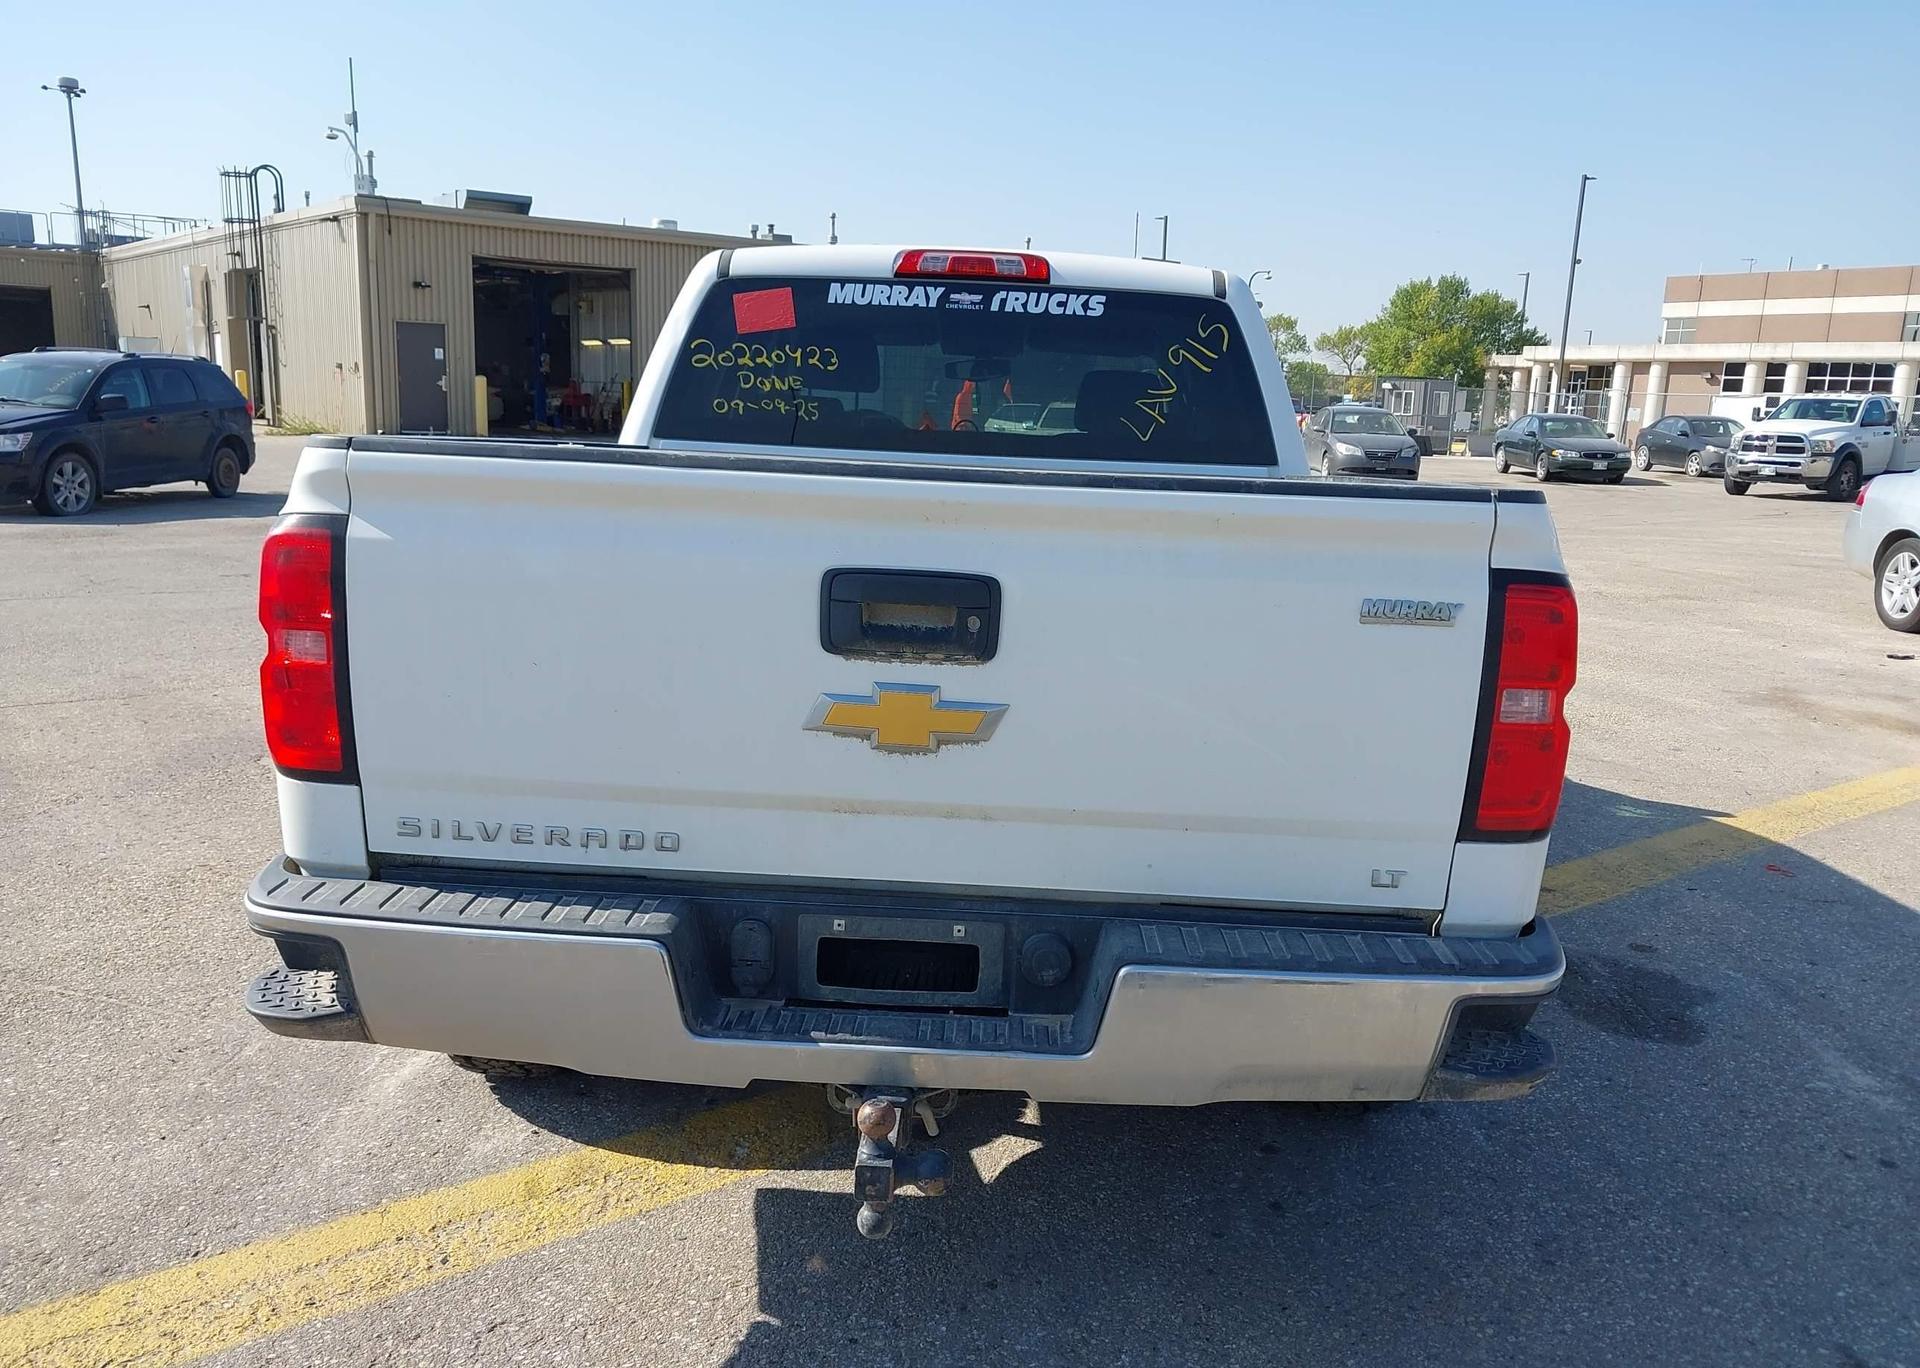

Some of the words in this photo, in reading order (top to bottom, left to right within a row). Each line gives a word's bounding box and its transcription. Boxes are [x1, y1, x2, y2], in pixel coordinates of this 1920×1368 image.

[827, 283, 946, 308] MURRAY
[990, 290, 1106, 316] TRUCKS
[691, 339, 839, 370] 20220423
[737, 371, 804, 391] DONE
[1360, 599, 1464, 622] MURRAY
[397, 816, 680, 852] SILVERADO
[1371, 869, 1408, 888] LT
